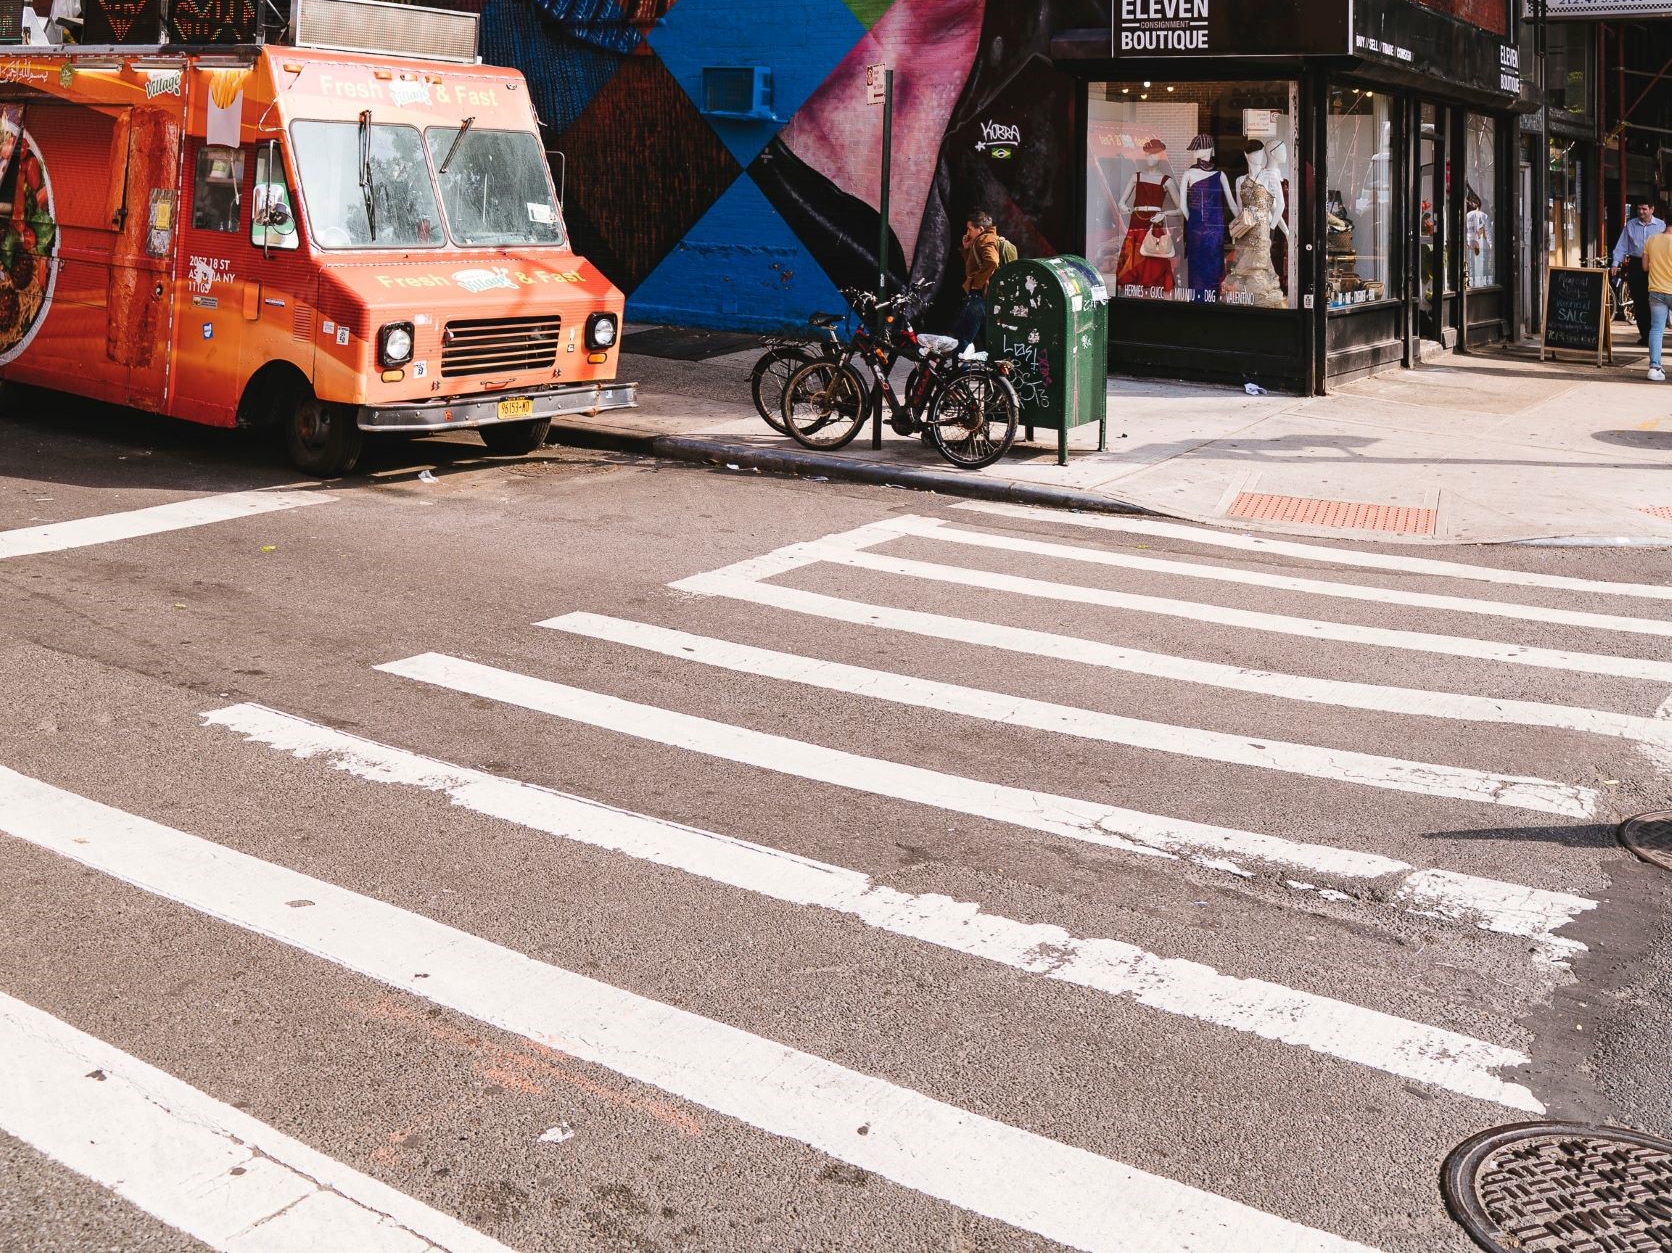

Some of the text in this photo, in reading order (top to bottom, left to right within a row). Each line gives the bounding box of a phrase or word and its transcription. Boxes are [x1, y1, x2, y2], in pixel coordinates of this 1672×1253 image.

[1140, 20, 1190, 29] CONSIGNMENT
[1121, 30, 1208, 50] BOUTIQUE
[1356, 35, 1366, 48] BUY
[1369, 39, 1379, 52] SELL
[1500, 45, 1519, 68] ELEVEN
[147, 74, 180, 98] Village
[320, 74, 383, 99] Fresh
[437, 84, 452, 104] &
[455, 85, 498, 107] Fast
[1500, 74, 1520, 94] BOUTIQUE
[980, 119, 1020, 143] KOBRA
[209, 257, 218, 269] 18
[219, 259, 230, 270] ST
[222, 272, 236, 284] NY
[374, 273, 450, 289] Fresh
[514, 271, 535, 285] &
[534, 269, 587, 284] Fast
[1204, 289, 1216, 303] D&G
[1226, 291, 1255, 306] VALENTINO
